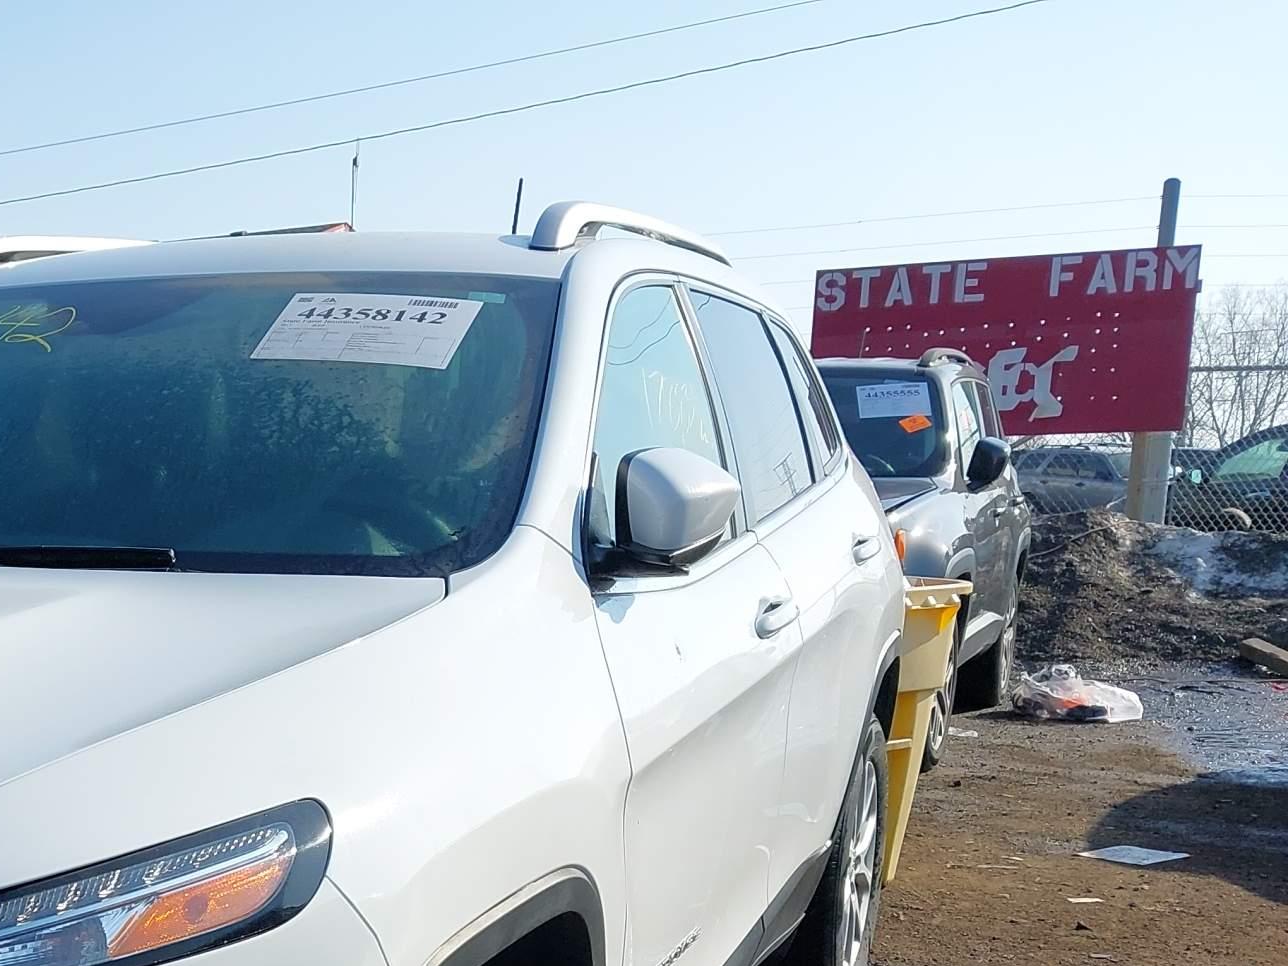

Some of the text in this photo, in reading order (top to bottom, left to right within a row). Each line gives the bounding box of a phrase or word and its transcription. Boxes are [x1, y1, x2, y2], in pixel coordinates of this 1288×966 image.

[817, 247, 1200, 312] STATE FARM
[297, 306, 449, 325] 44358142
